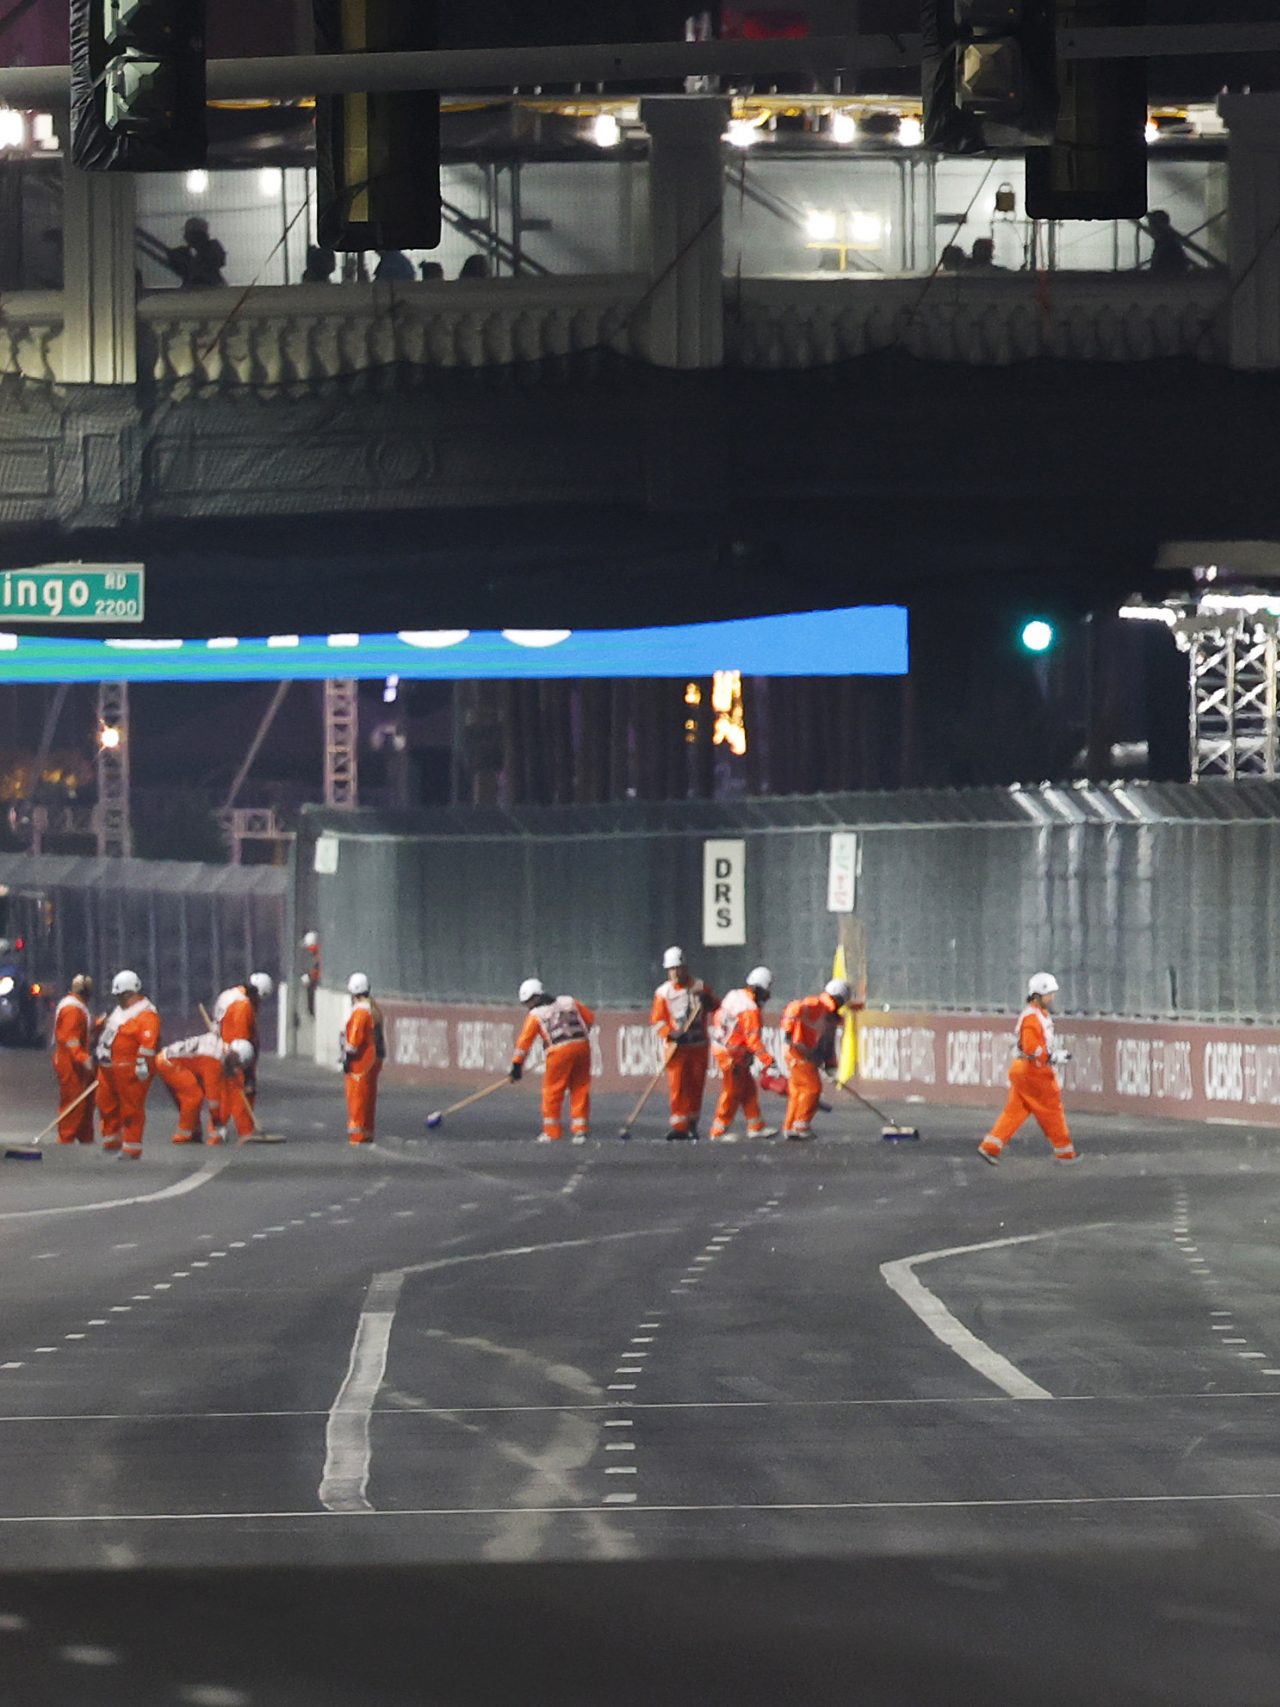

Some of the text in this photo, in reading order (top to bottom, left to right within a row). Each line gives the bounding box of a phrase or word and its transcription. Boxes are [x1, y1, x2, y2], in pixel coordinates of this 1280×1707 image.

[3, 572, 89, 616] ingo
[104, 573, 127, 590] RD
[95, 599, 137, 616] 2200
[714, 858, 732, 928] DRS
